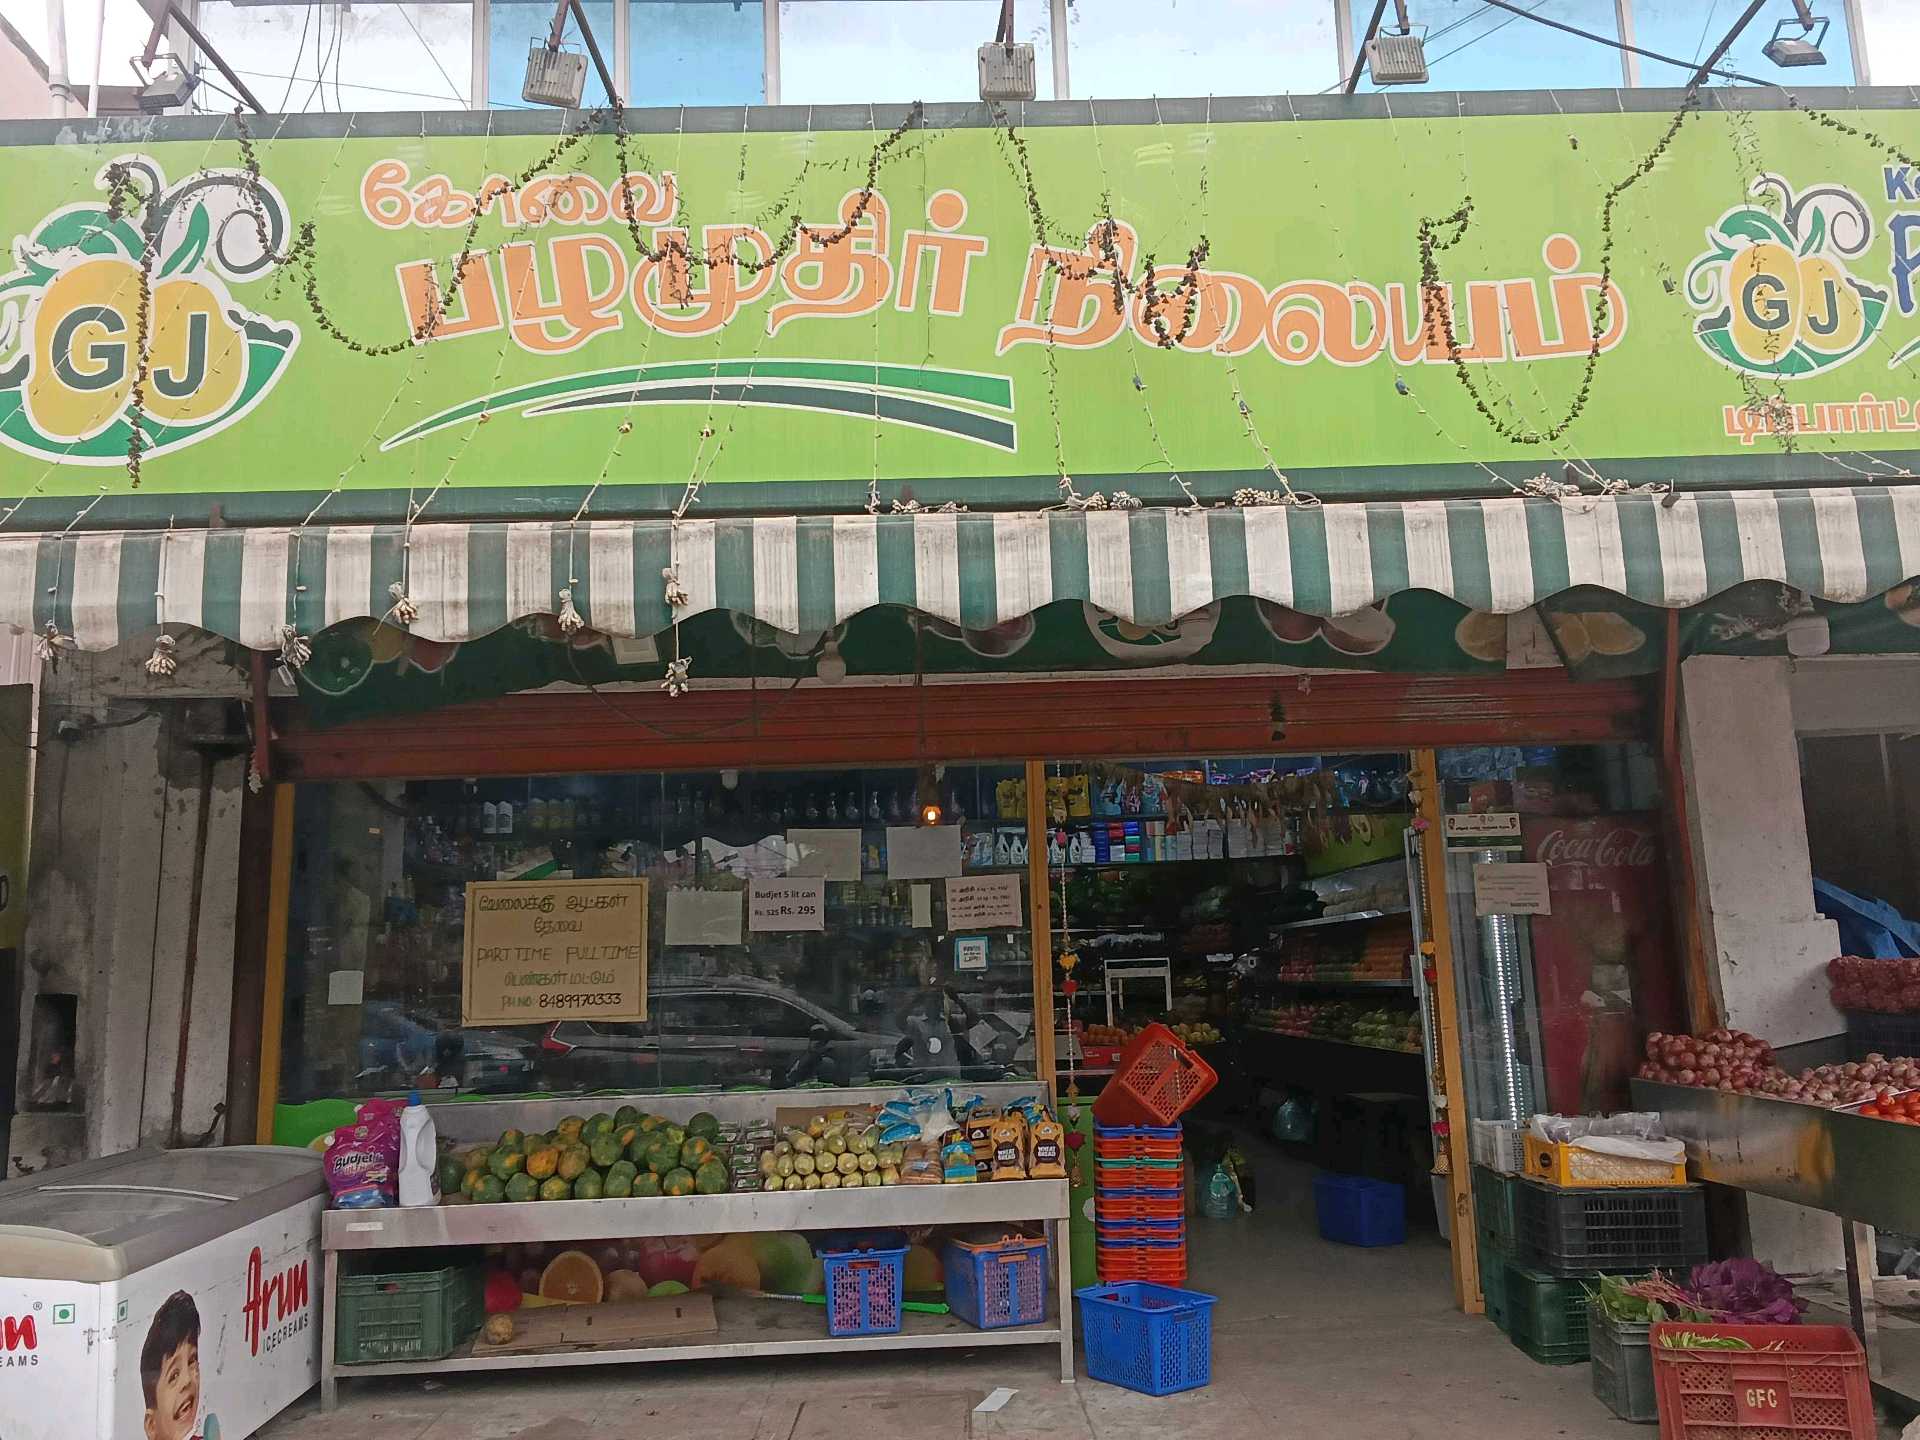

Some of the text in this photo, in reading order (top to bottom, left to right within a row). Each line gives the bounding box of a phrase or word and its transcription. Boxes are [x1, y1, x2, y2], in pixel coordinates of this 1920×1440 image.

[362, 159, 680, 229] கோவை
[396, 188, 1627, 365] பழமுதிர் நிலையம்
[1536, 827, 1656, 867] Coca-Cola
[755, 890, 781, 900] Budjet
[784, 890, 789, 898] 5
[791, 890, 799, 898] lit
[798, 905, 816, 915] 295
[534, 916, 583, 937] தேவை
[538, 992, 622, 1009] 8489970333
[334, 1152, 374, 1172] Budjet
[243, 1246, 308, 1357] Arun
[263, 1312, 308, 1354] ICECREAMS
[1746, 1388, 1777, 1408] GFC
